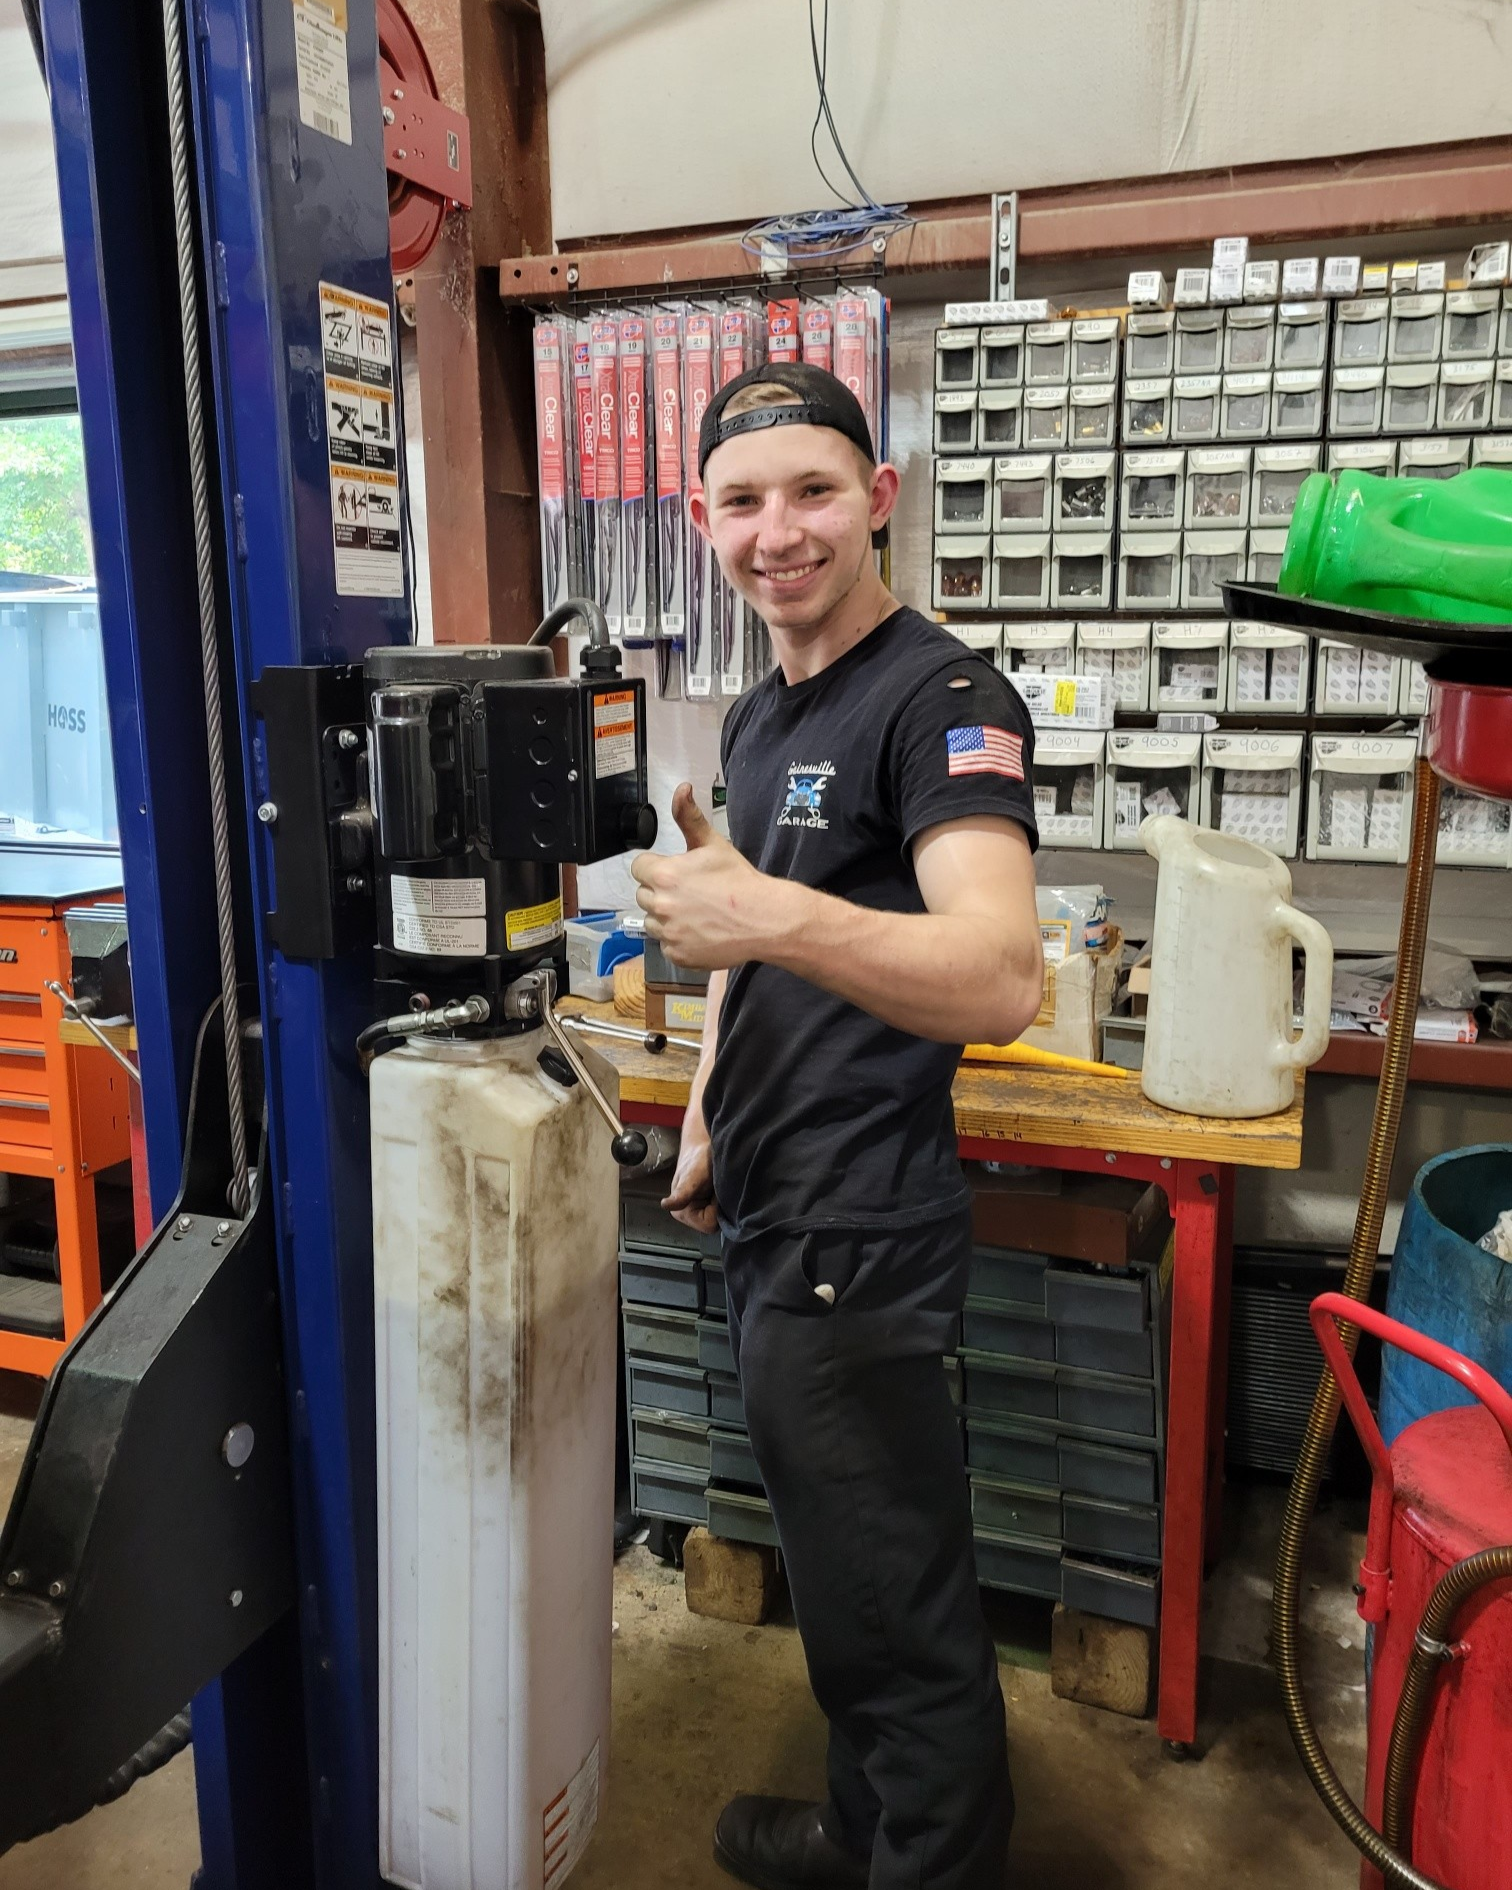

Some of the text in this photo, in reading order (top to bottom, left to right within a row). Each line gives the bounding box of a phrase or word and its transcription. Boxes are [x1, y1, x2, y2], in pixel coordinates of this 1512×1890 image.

[845, 323, 857, 331] 28
[660, 338, 671, 346] 20
[727, 335, 737, 343] 22
[775, 337, 786, 345] 24
[543, 348, 552, 356] 15
[628, 342, 637, 350] 19
[600, 393, 614, 440] Clear
[627, 392, 640, 440] Clear
[663, 388, 676, 438] Clear
[545, 397, 557, 442] Clear
[583, 412, 593, 458] Clear
[956, 626, 970, 636] H1
[1030, 626, 1048, 636] H3
[1098, 626, 1113, 637] H4
[48, 703, 86, 733] HOSS
[1046, 735, 1081, 747] 9004
[1141, 736, 1180, 748] 9005
[1239, 738, 1280, 753] 9006
[1351, 740, 1394, 756] 9007
[776, 816, 830, 830] GARAGE
